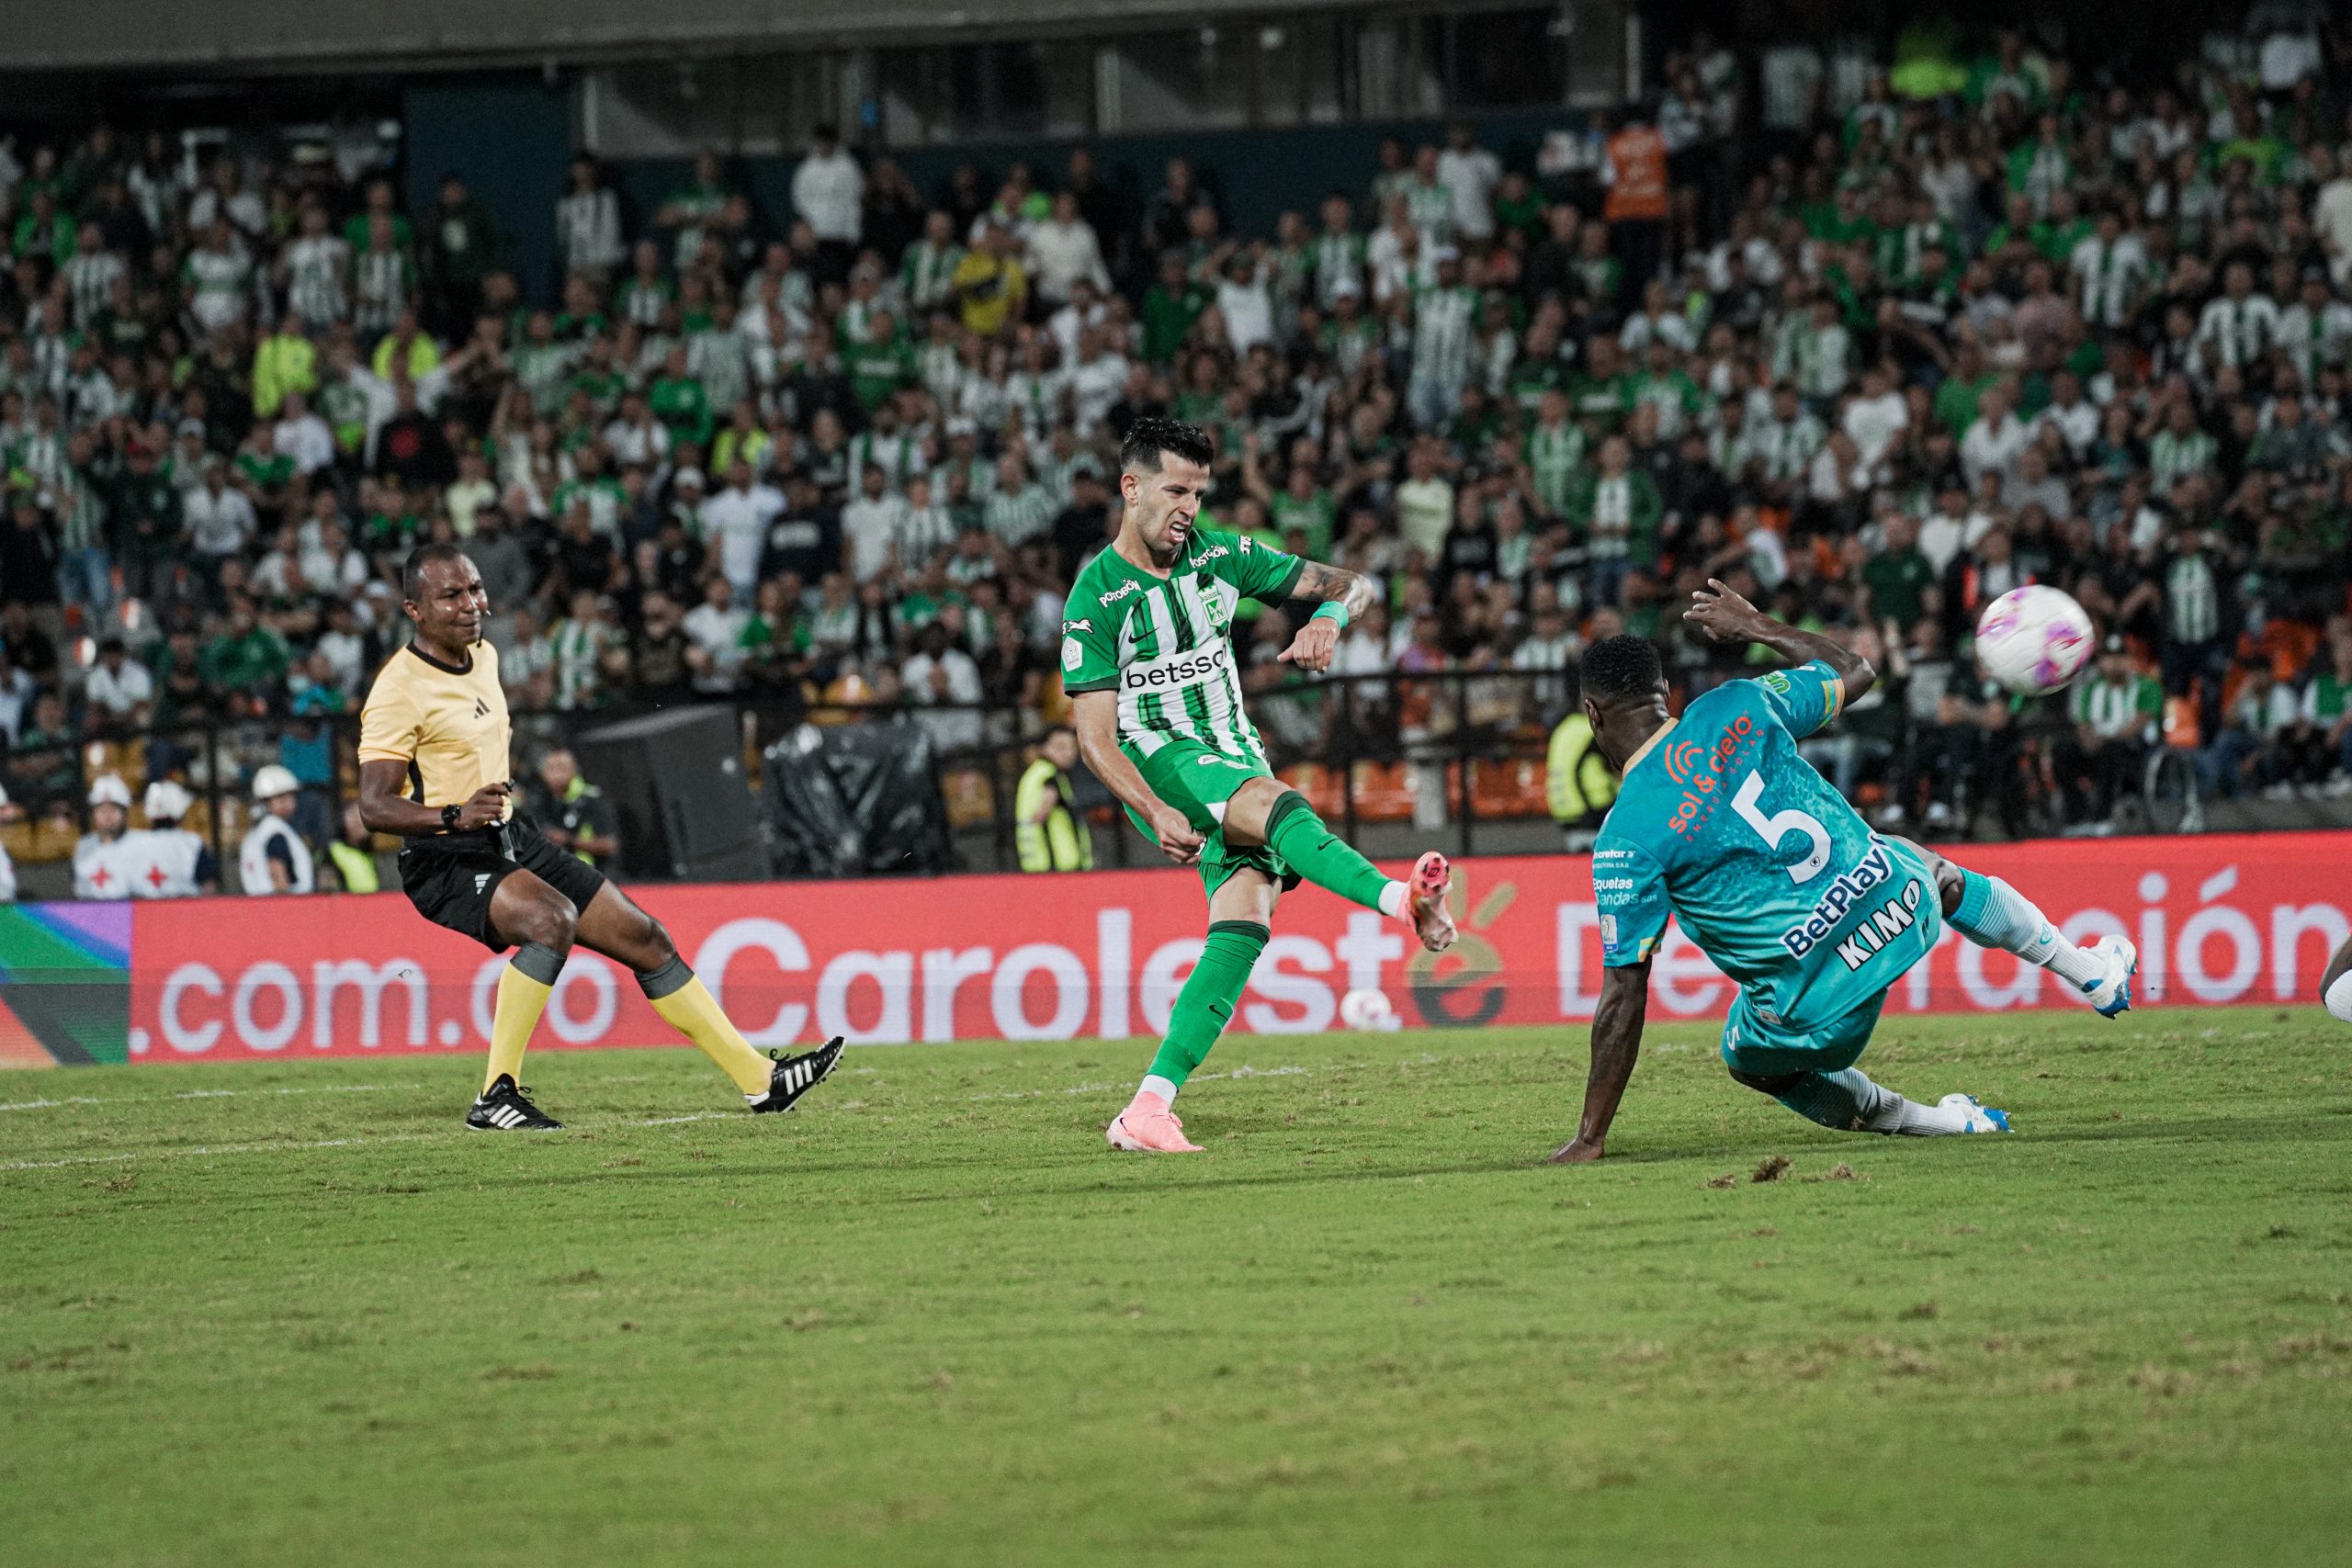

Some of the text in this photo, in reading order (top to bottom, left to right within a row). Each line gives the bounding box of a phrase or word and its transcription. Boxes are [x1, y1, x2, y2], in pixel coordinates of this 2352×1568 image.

[1126, 643, 1227, 689] betsso
[1668, 716, 1752, 834] sol & cielo
[1730, 768, 1832, 885] 5
[1782, 847, 1892, 958] BetPlay
[1835, 878, 1922, 972] KIMO
